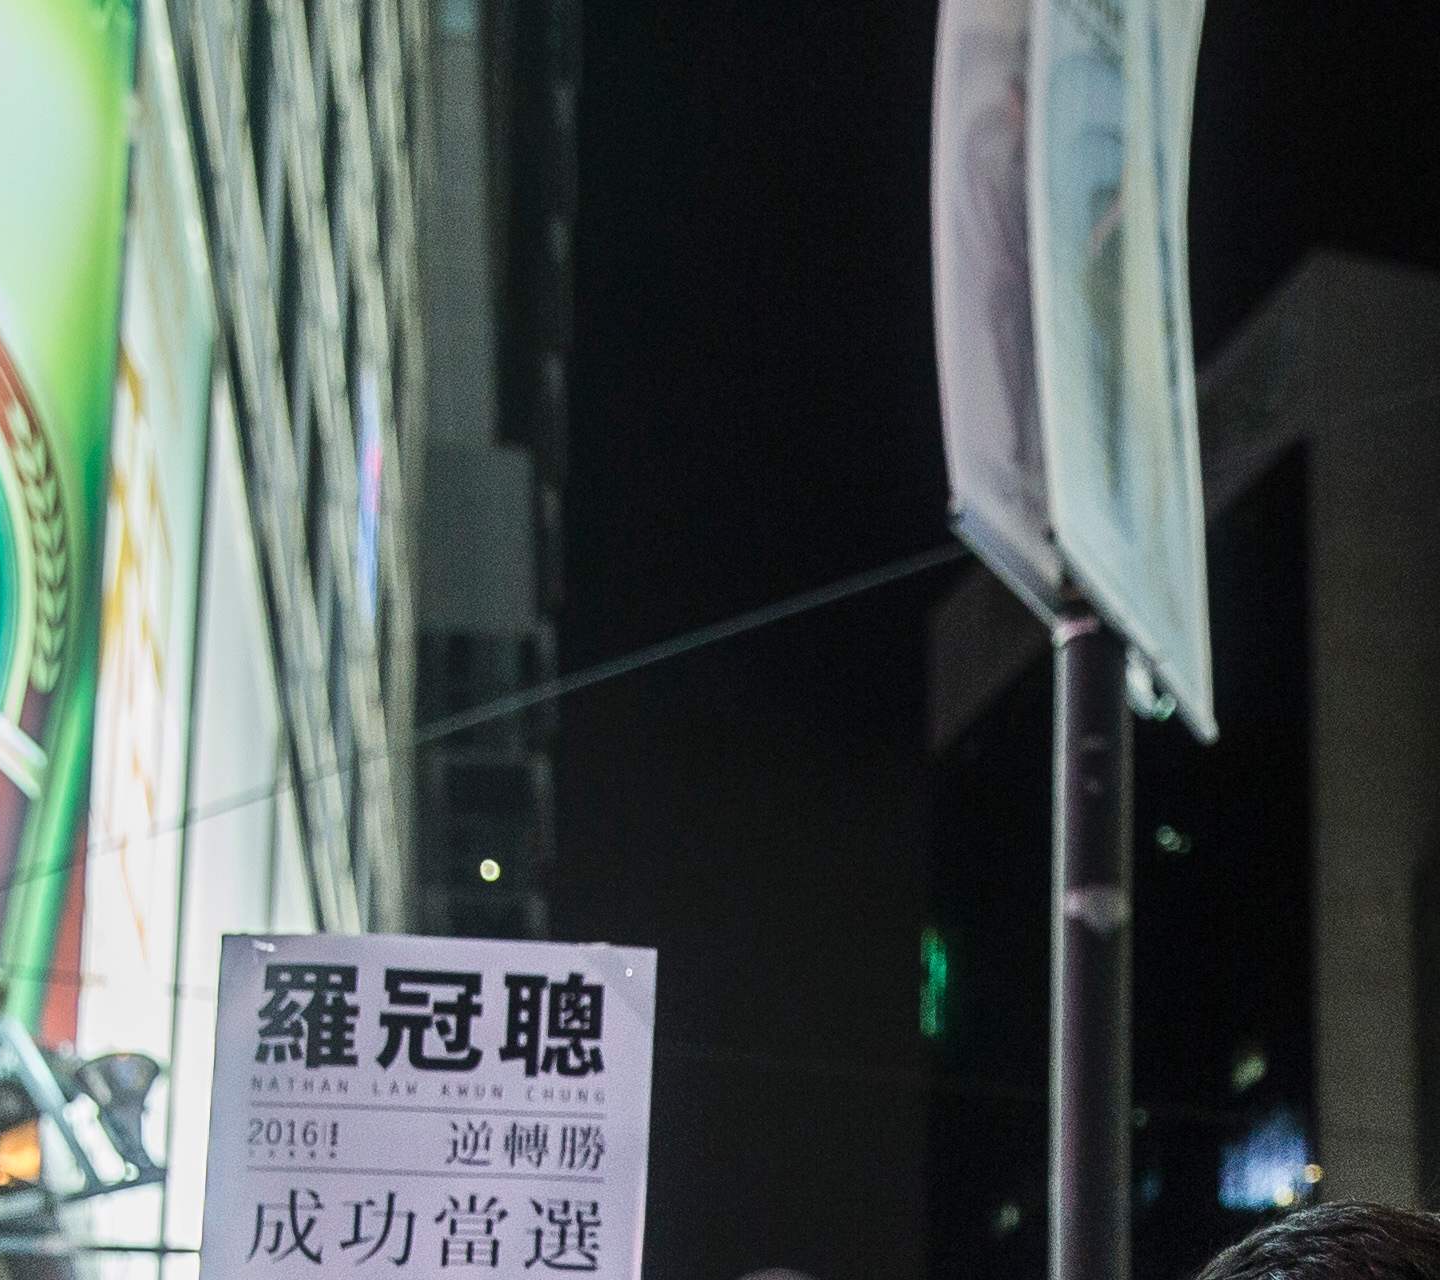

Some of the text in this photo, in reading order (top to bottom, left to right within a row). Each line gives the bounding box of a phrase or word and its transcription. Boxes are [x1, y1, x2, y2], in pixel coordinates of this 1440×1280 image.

[254, 964, 605, 1078] 羅冠聰
[446, 1120, 606, 1169] 逆轉勝
[246, 1188, 603, 1272] 成功當選
